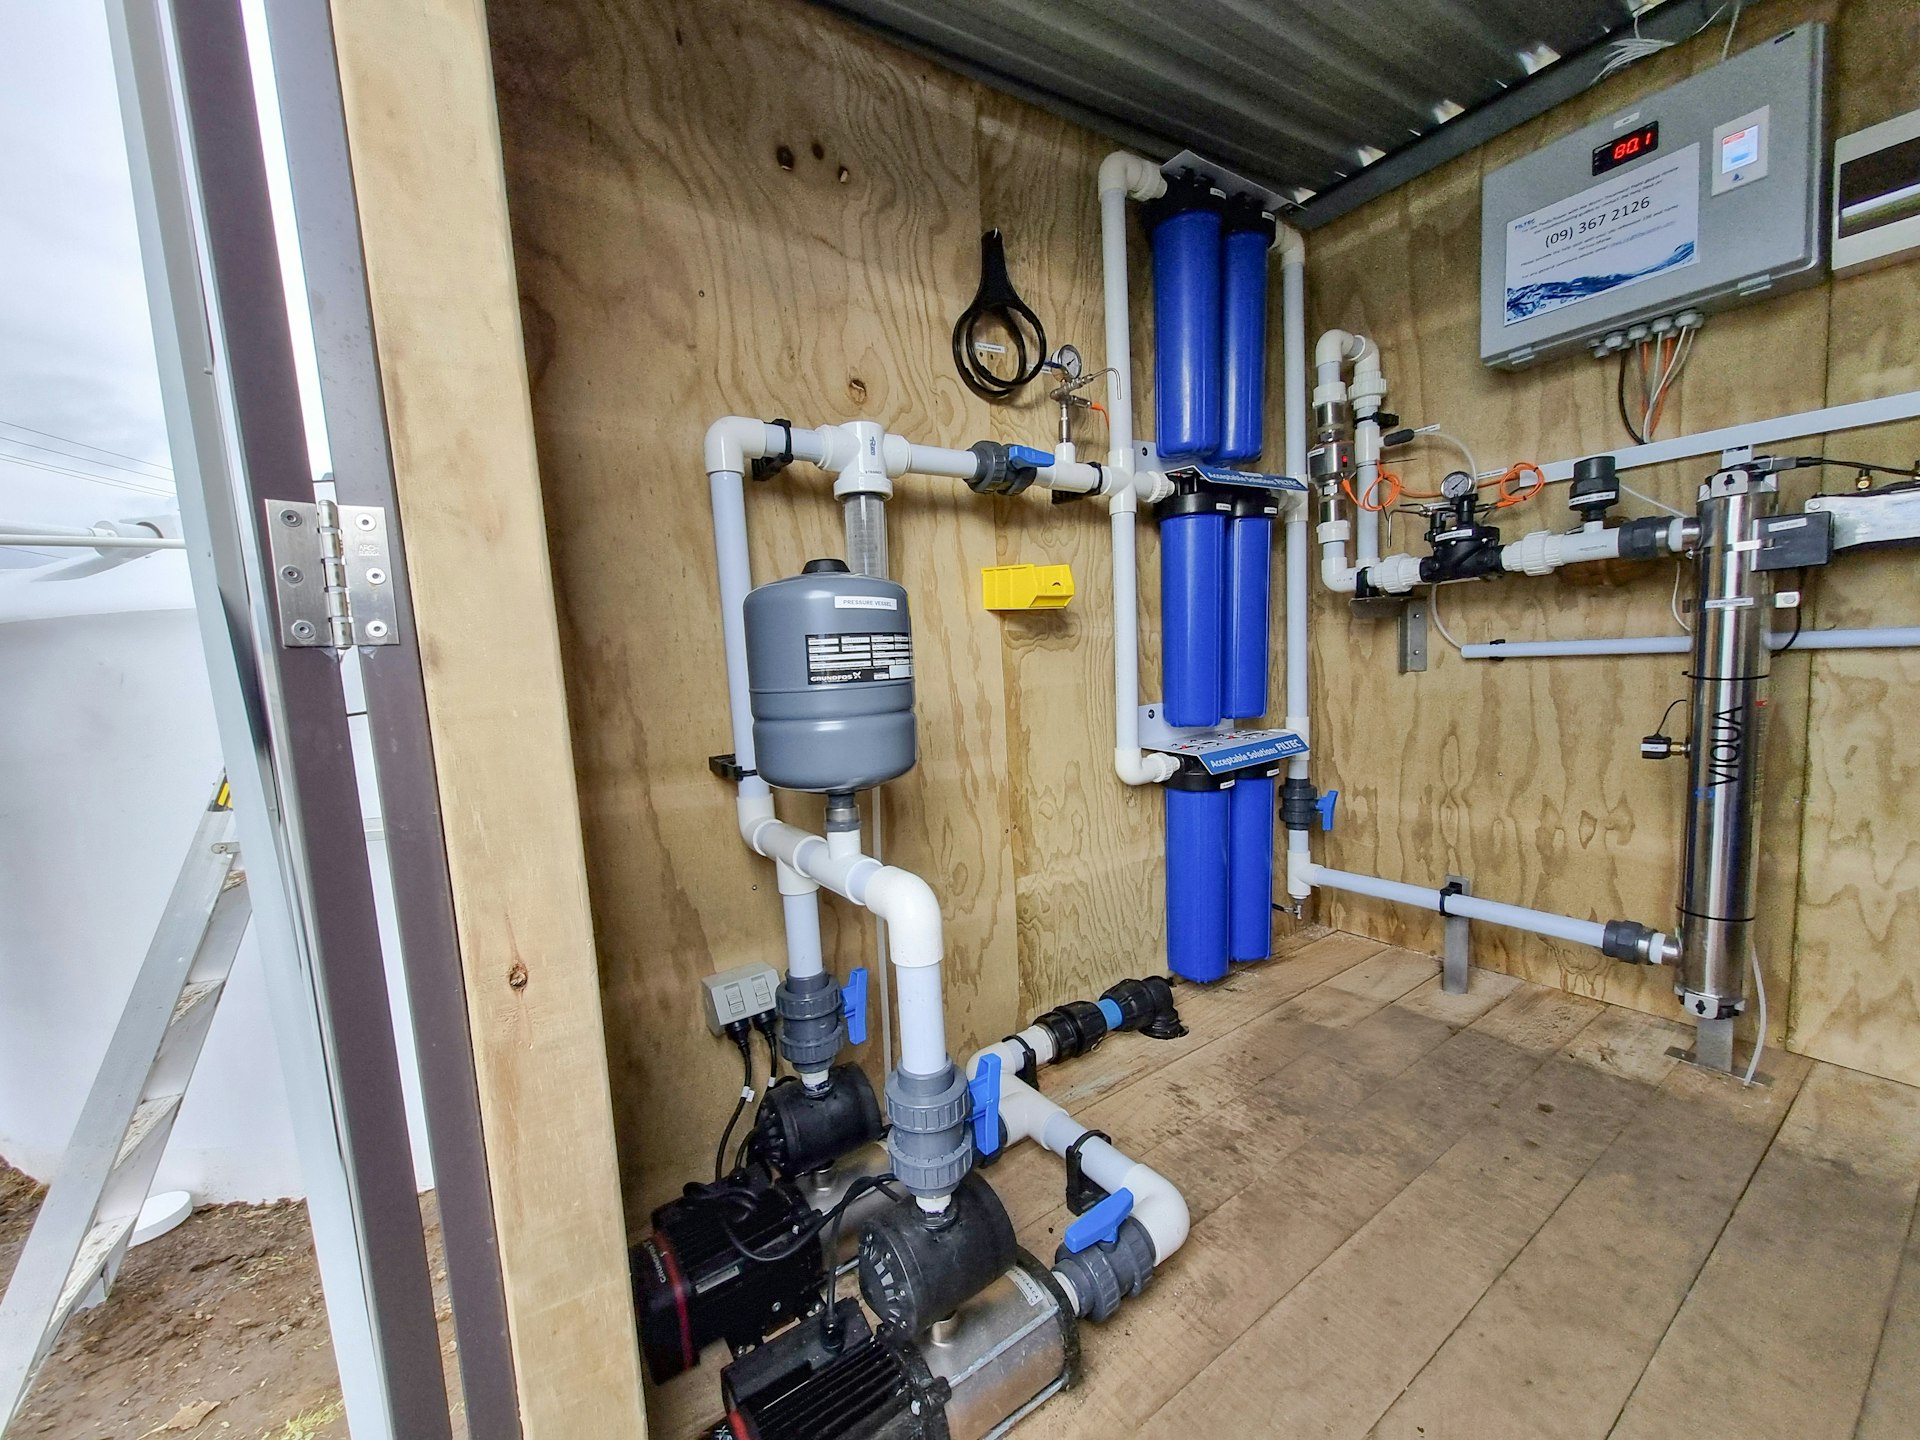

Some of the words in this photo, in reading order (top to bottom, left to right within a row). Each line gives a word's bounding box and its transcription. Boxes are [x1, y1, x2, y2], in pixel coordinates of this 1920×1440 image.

[1545, 226, 1574, 248] (09)
[1578, 213, 1607, 234] 367
[1611, 196, 1650, 221] 2126
[1210, 752, 1249, 767] Acceptable
[1247, 748, 1277, 759] Solutions
[1275, 739, 1302, 751] FILTEC
[1707, 706, 1743, 788] VIQUA
